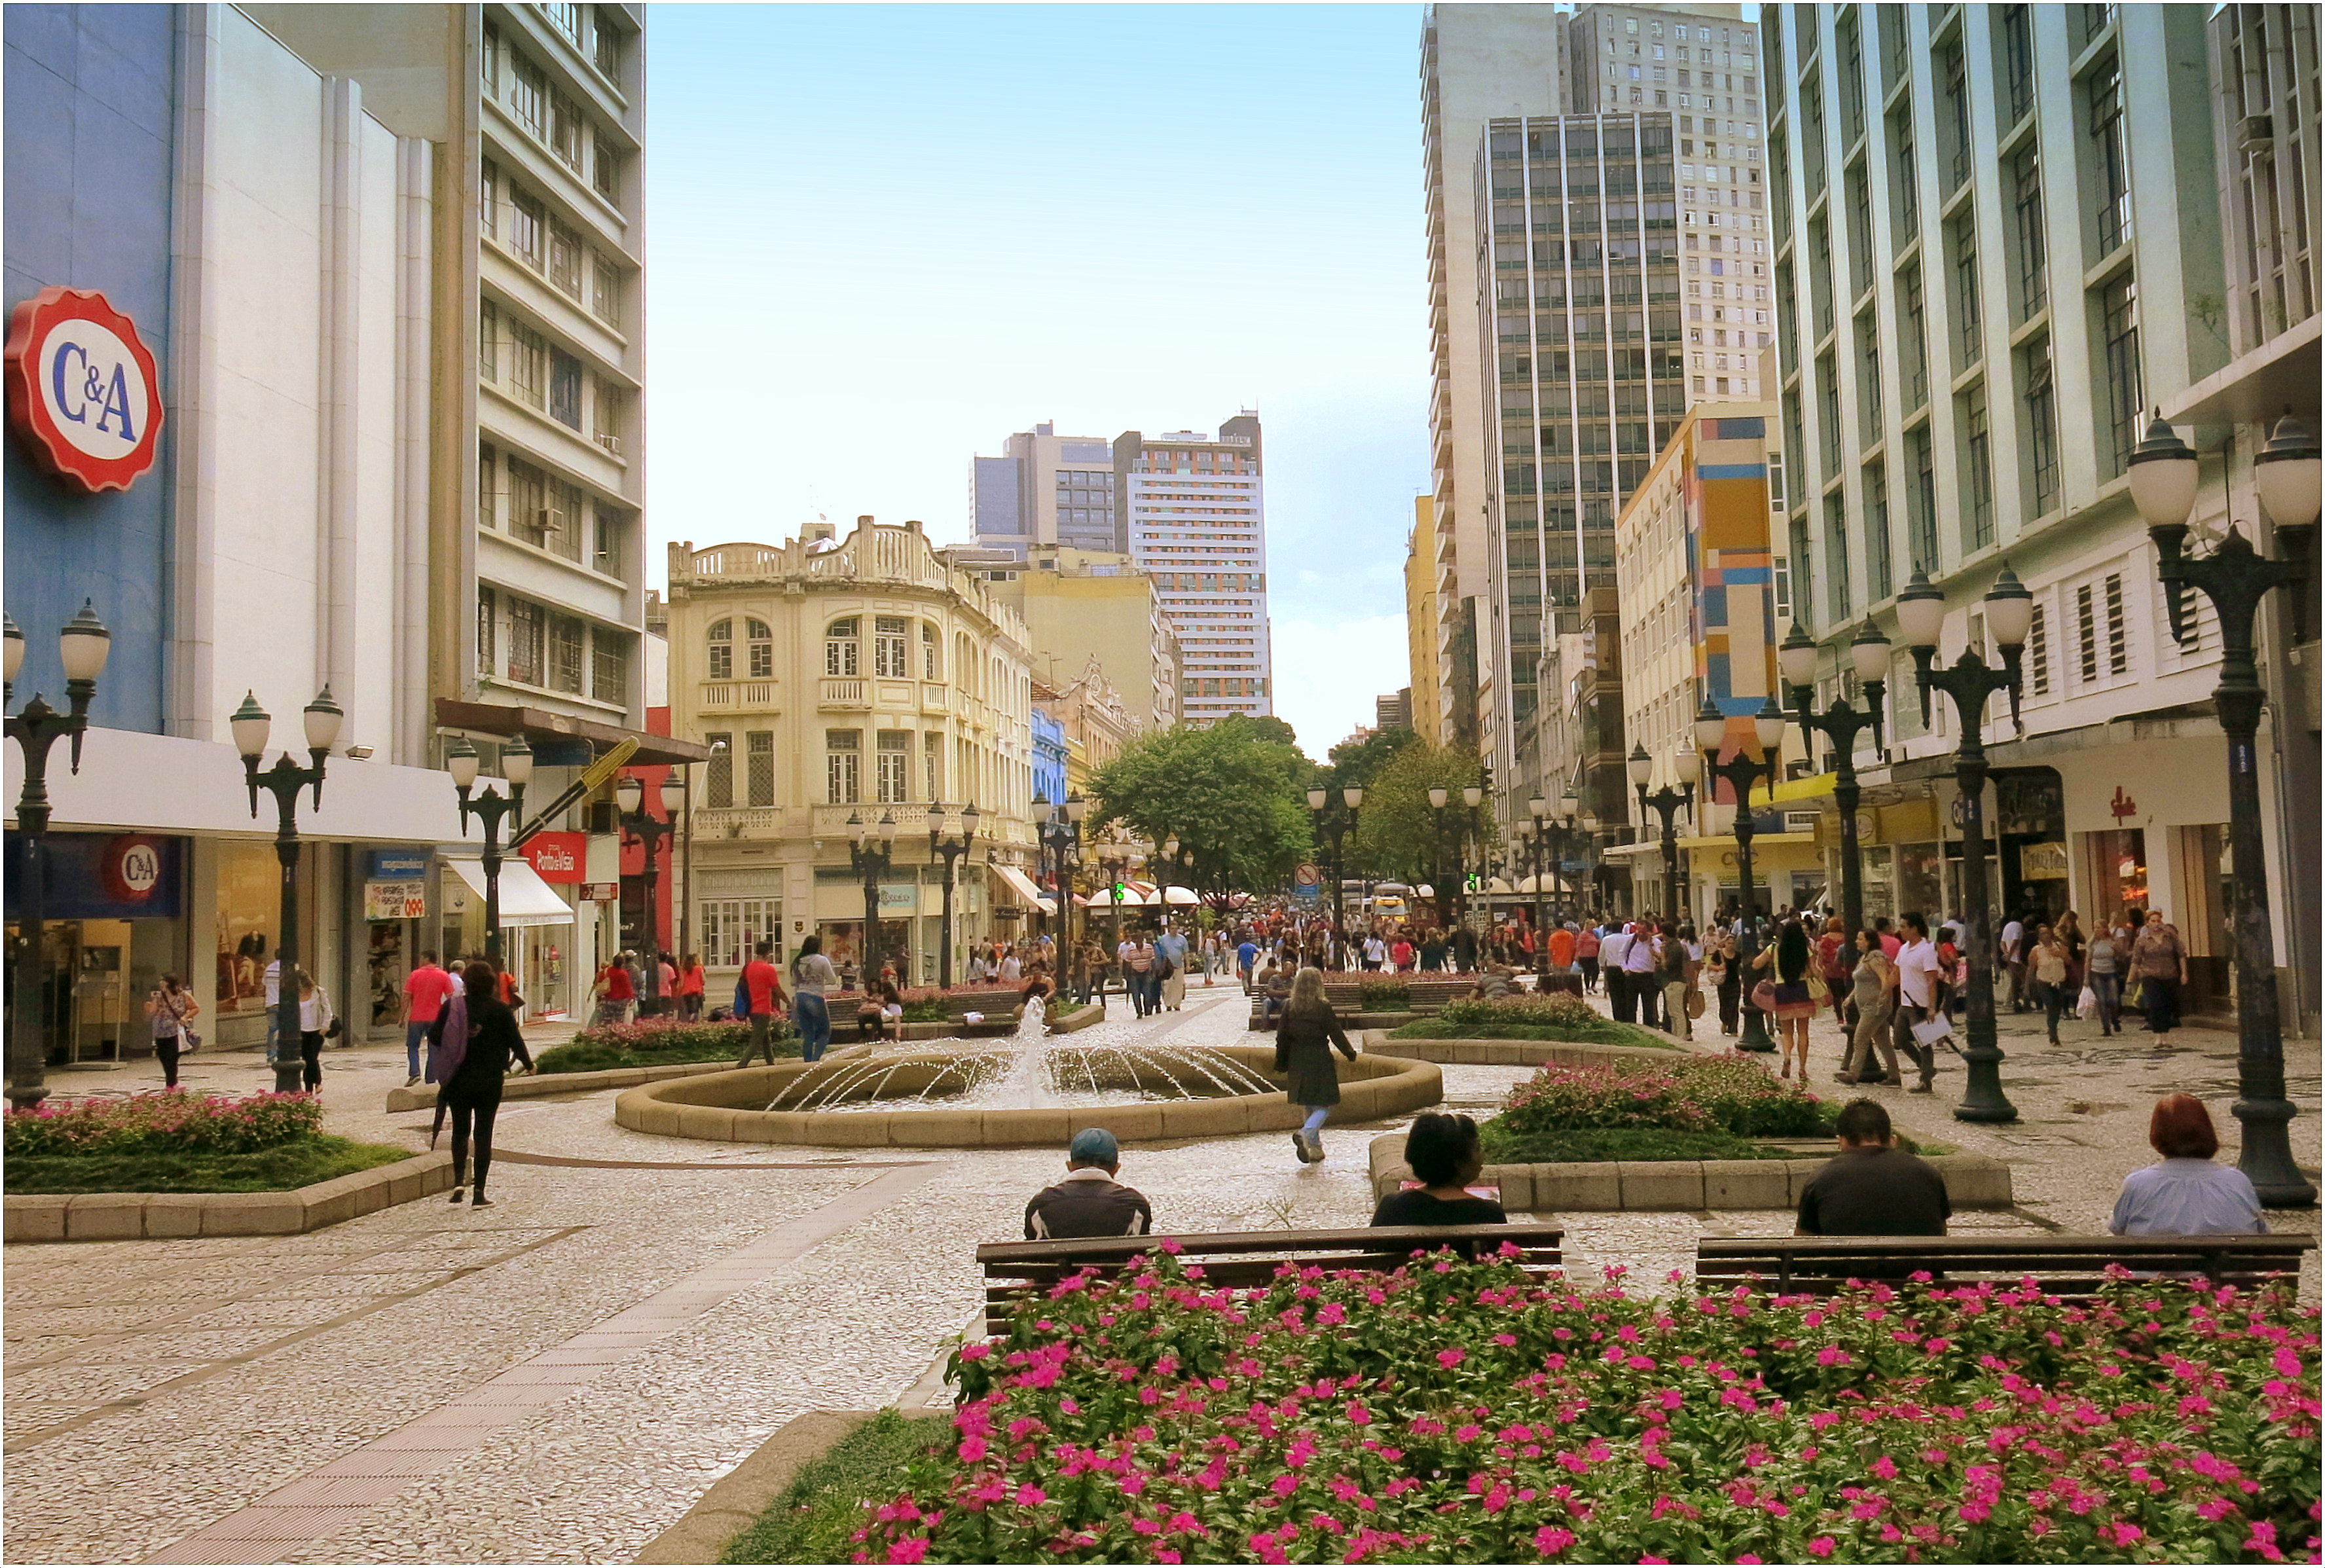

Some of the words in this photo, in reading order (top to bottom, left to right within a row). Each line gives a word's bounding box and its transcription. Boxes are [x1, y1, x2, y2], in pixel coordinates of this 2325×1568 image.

[52, 341, 136, 443] C&A
[126, 853, 155, 881] C&A
[537, 850, 554, 870] Ponto
